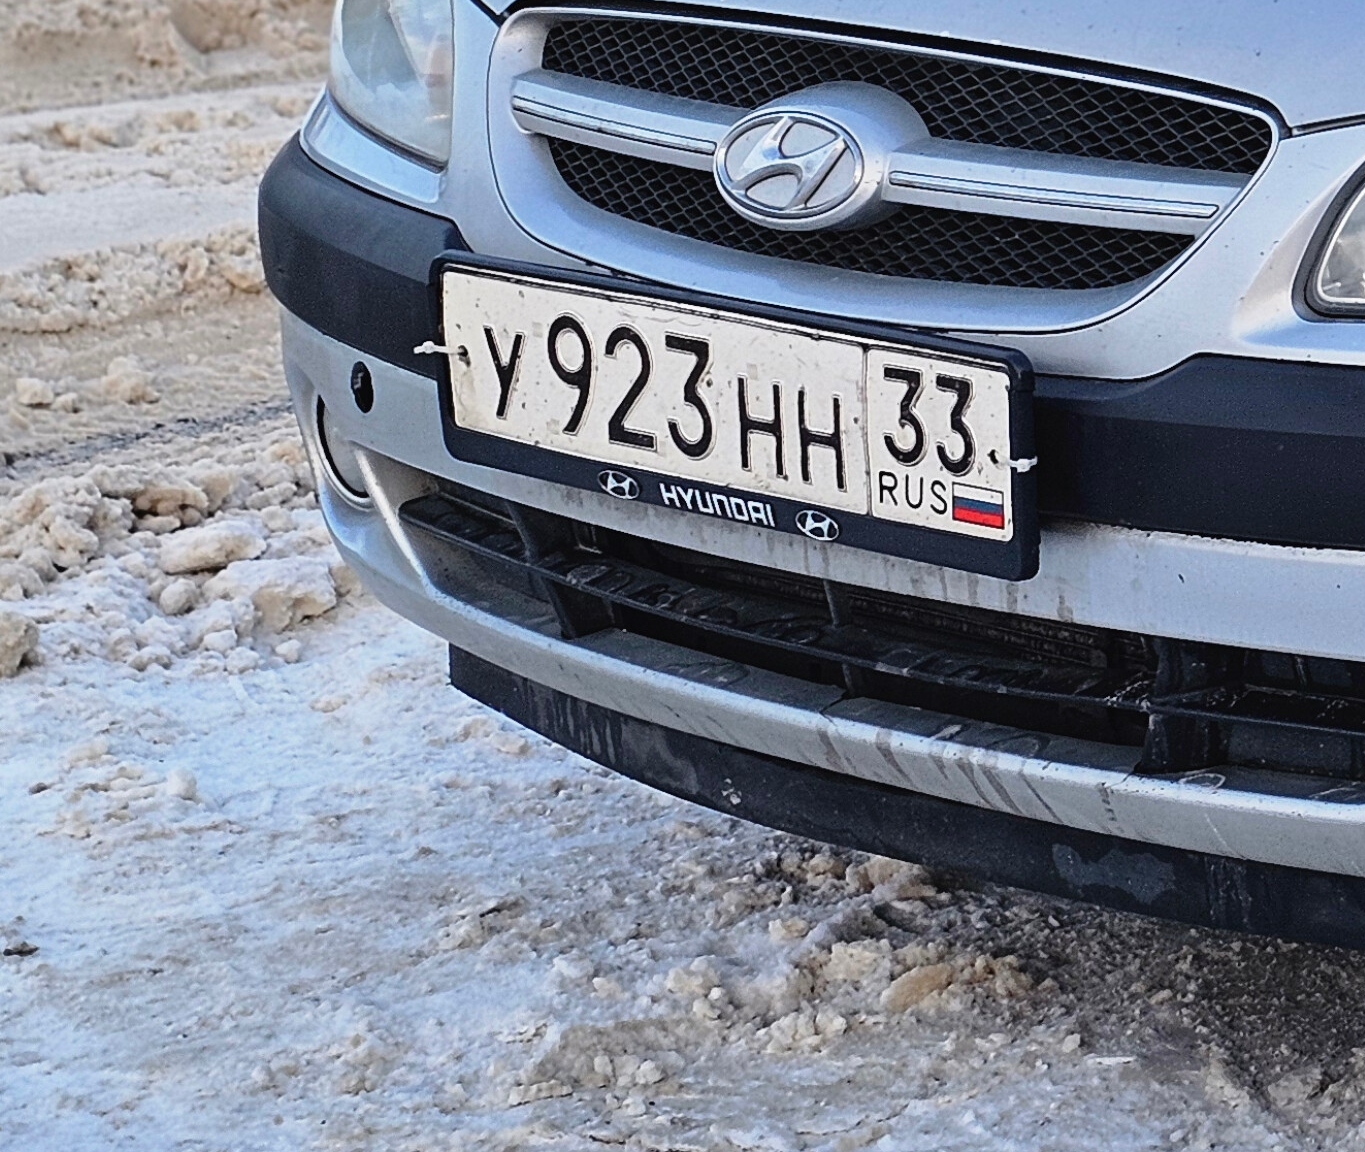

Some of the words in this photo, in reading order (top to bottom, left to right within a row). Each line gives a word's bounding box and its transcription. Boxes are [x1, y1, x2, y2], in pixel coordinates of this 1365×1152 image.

[882, 366, 976, 476] 33
[659, 483, 776, 528] HYUNDAI
[879, 470, 948, 515] RUS
